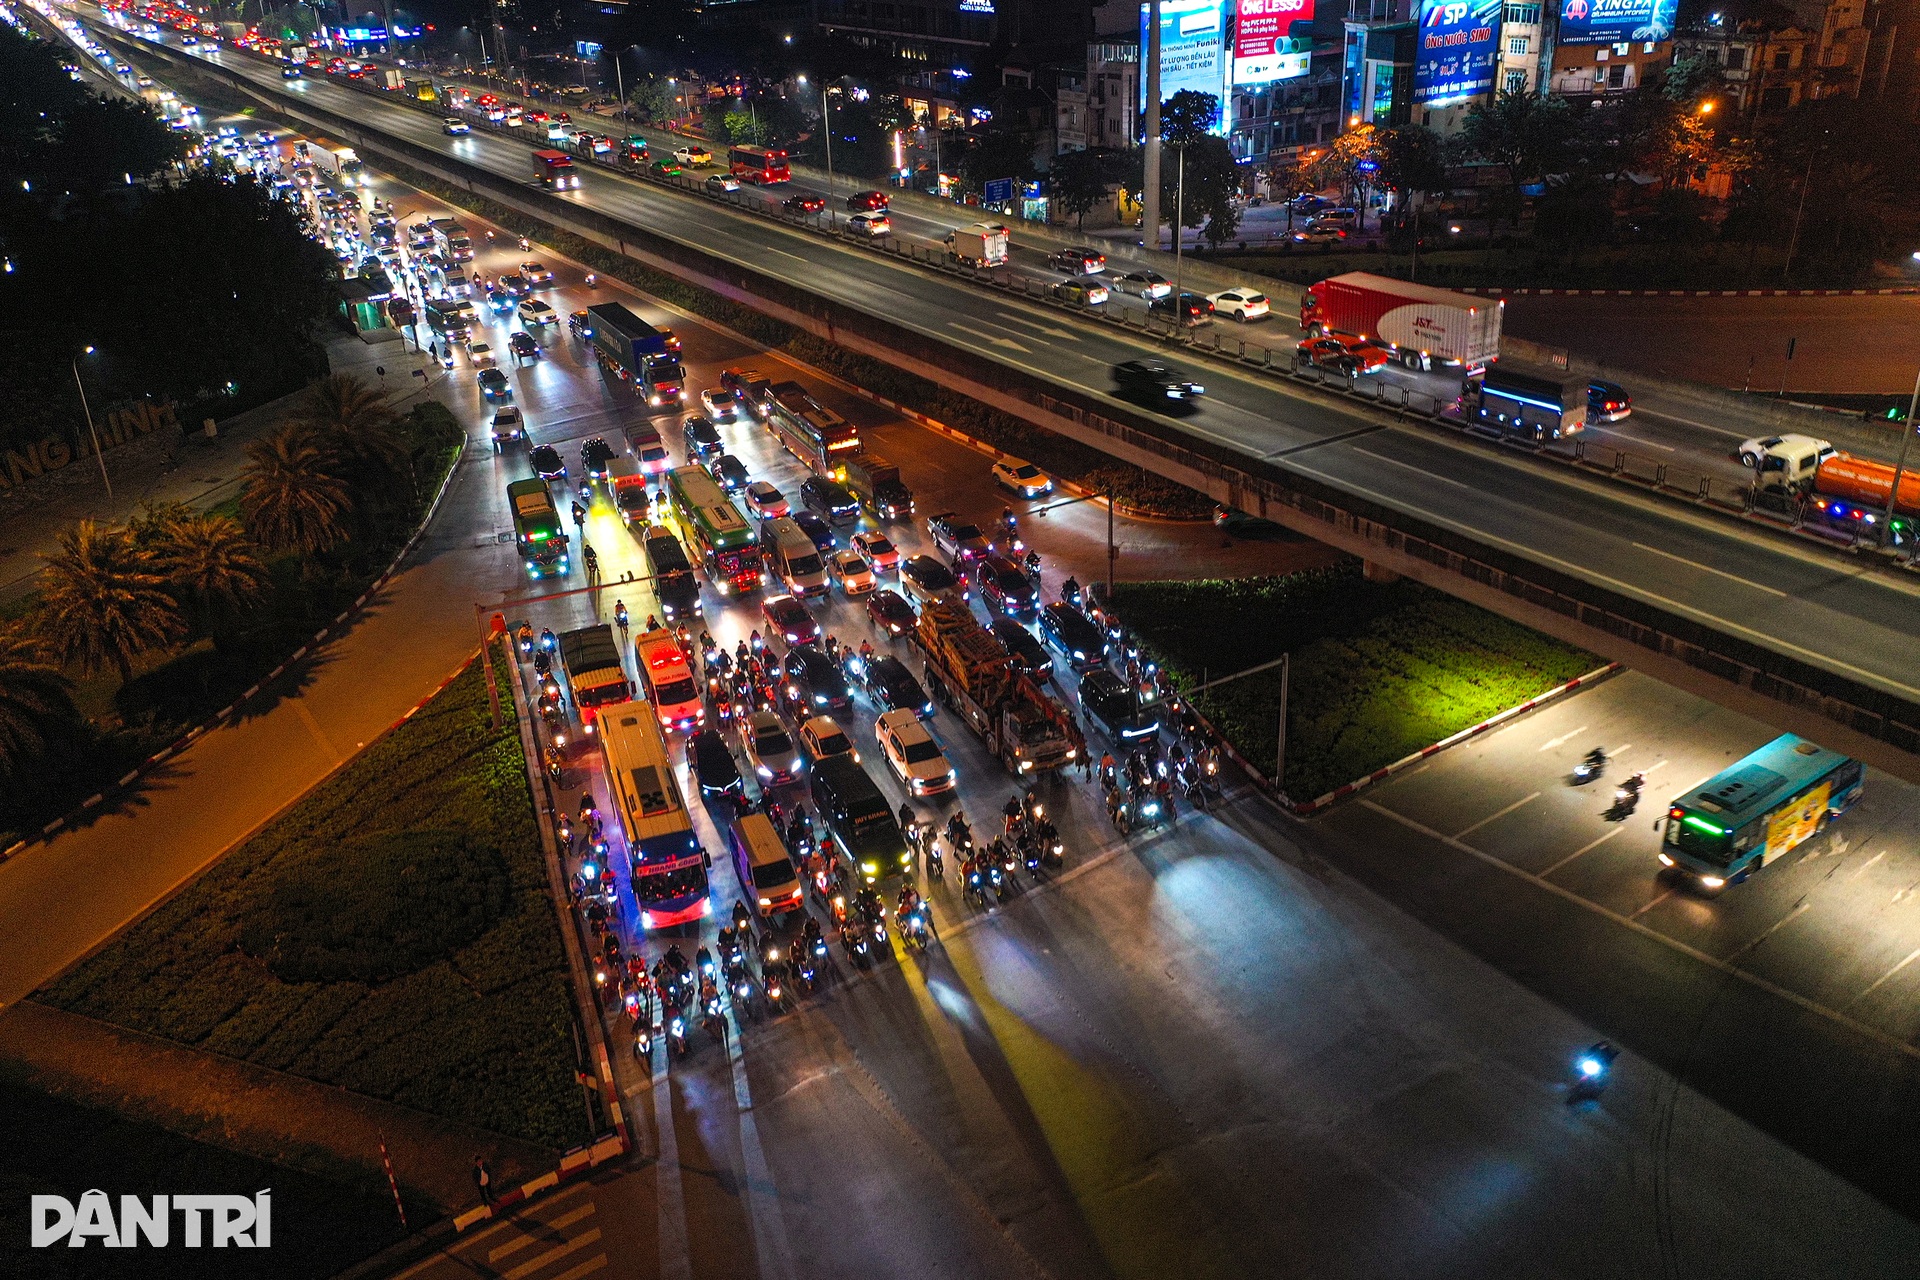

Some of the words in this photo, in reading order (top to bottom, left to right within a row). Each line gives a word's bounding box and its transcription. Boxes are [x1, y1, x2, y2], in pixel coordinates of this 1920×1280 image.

[1264, 0, 1304, 13] LESSO
[1443, 2, 1468, 25] SP
[1196, 38, 1220, 48] Funiki
[1425, 32, 1443, 49] ỐNG
[1444, 29, 1468, 47] NƯỚC
[1469, 27, 1491, 43] SINO
[1170, 63, 1182, 73] SÂU
